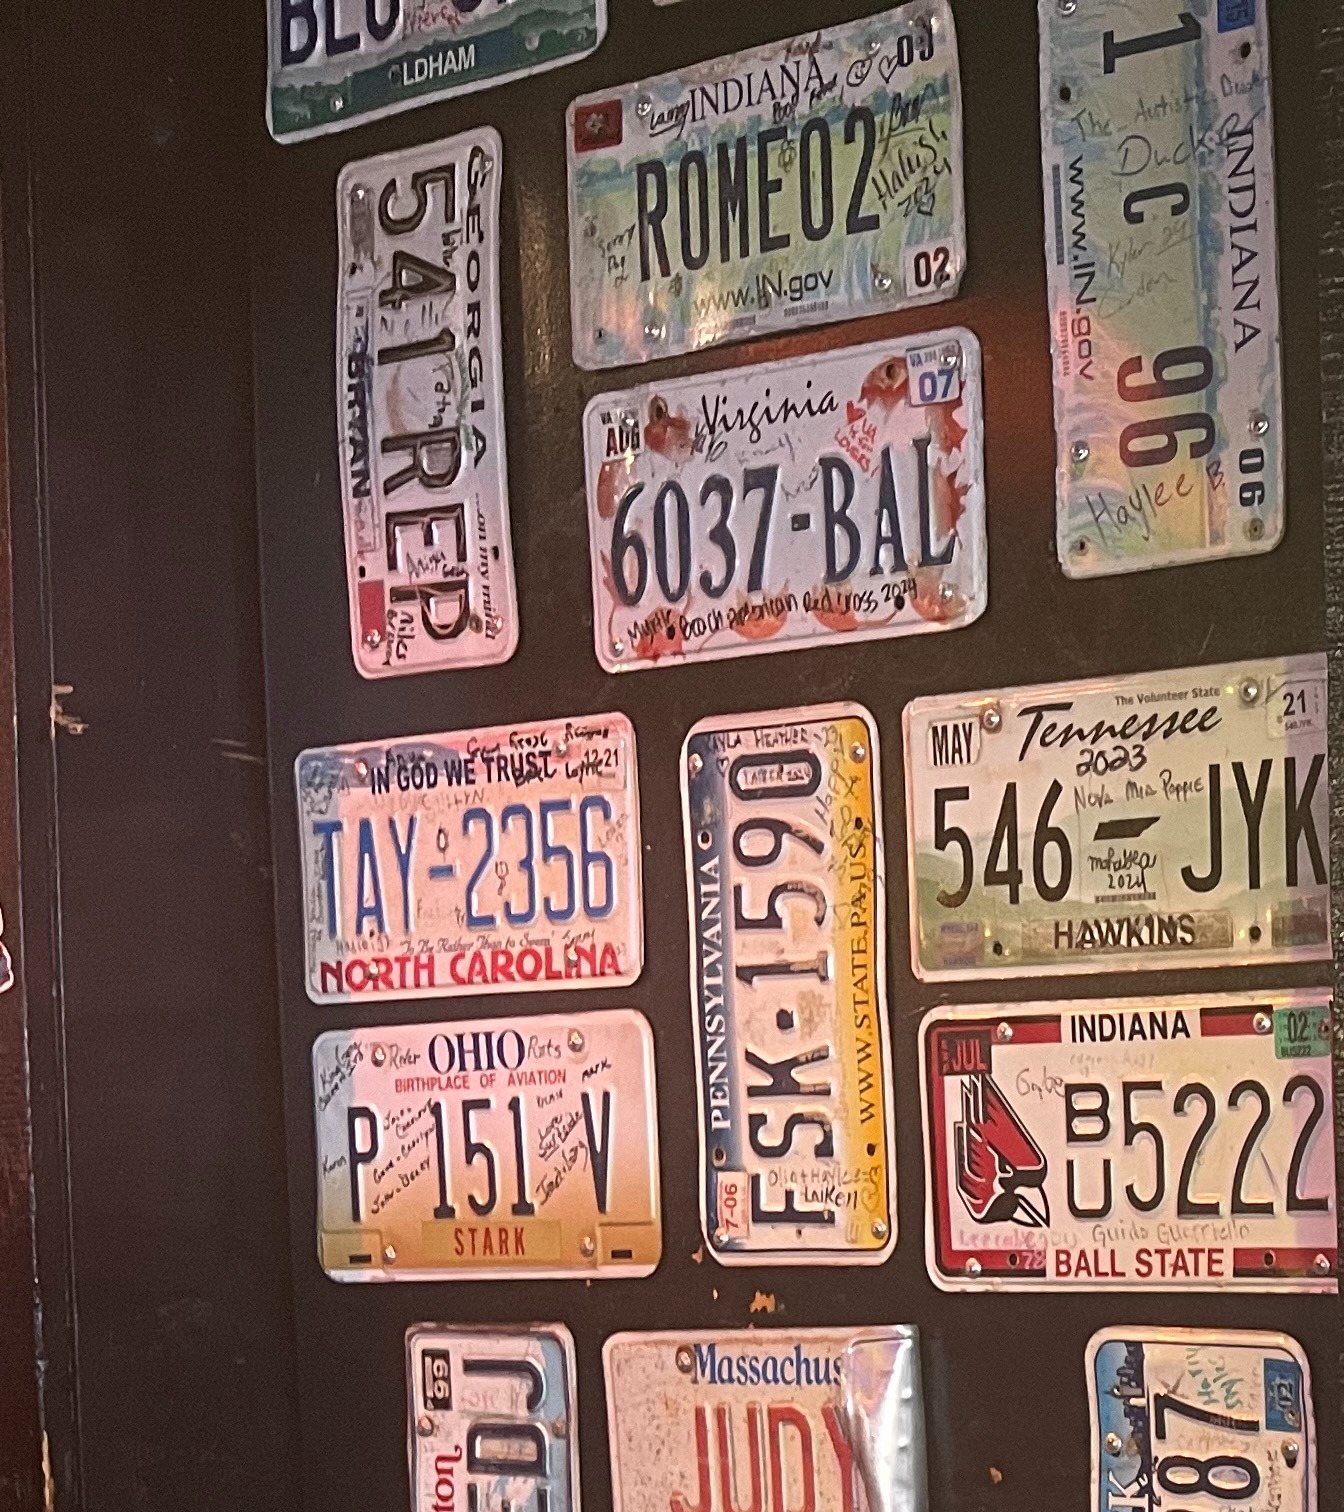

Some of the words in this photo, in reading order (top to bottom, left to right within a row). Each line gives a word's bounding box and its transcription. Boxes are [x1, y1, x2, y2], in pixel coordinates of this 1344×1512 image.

[689, 54, 826, 122] INDIANA
[636, 105, 881, 283] ROME02
[1227, 125, 1262, 353] INDIANA
[913, 246, 950, 288] 02
[466, 145, 488, 470] GEORGIA
[918, 371, 953, 402] 07
[1116, 345, 1217, 468] 96
[702, 381, 838, 443] Virginia
[1238, 447, 1266, 508] 06
[611, 437, 956, 607] 6037-BAL
[1282, 691, 1307, 717] 21
[931, 722, 974, 766] MAY
[1017, 703, 1222, 762] Tennessee
[371, 767, 391, 795] IN
[397, 762, 438, 792] GOD
[445, 759, 476, 787] WE
[487, 748, 545, 784] TRUST
[1075, 744, 1148, 777] 2023
[934, 779, 1073, 909] 546
[1181, 753, 1328, 894] JYK
[313, 795, 614, 942] TAY-2356
[1054, 913, 1198, 950] HAWKINS
[320, 952, 436, 994] NORTH
[449, 942, 623, 987] CAROLINA
[699, 855, 732, 1133] PENNSYLVANIA
[428, 1029, 525, 1074] OHIO
[1070, 1010, 1192, 1043] INDIANA
[395, 1071, 471, 1094] BIRTHPLACE
[479, 1070, 497, 1088] OF
[507, 1068, 567, 1088] AVIATION
[953, 1041, 988, 1073] JUL
[347, 1105, 379, 1223] P
[433, 1095, 536, 1220] 151
[580, 1089, 611, 1216] V
[723, 1182, 739, 1230] 7-06
[453, 1226, 526, 1257] STARK
[1055, 1247, 1127, 1279] BALL
[1135, 1246, 1226, 1278] STATE
